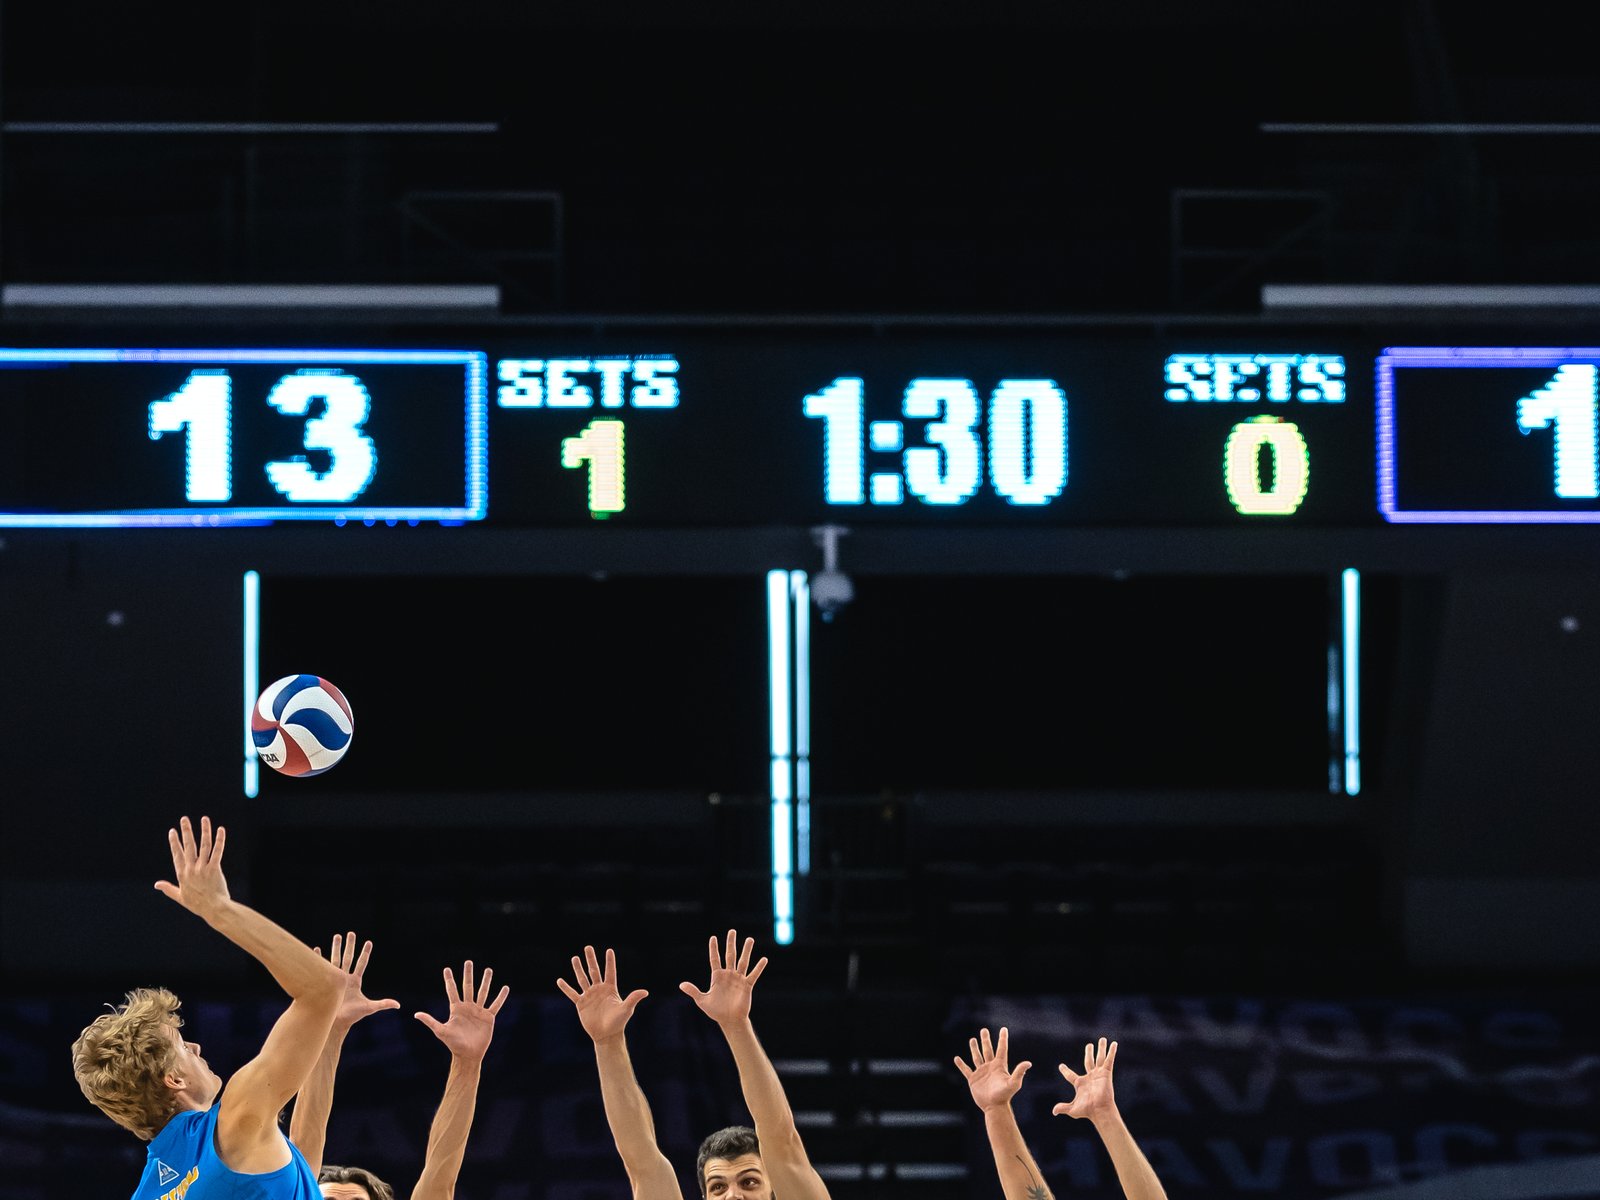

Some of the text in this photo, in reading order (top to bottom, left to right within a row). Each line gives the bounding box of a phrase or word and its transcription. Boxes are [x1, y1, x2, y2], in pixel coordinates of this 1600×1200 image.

[497, 356, 680, 408] SETS
[1164, 354, 1346, 403] SETS
[148, 369, 379, 503] 13
[561, 418, 626, 516] 1
[803, 376, 1070, 506] 1:30
[1223, 416, 1310, 516] 0
[258, 752, 280, 763] CAA
